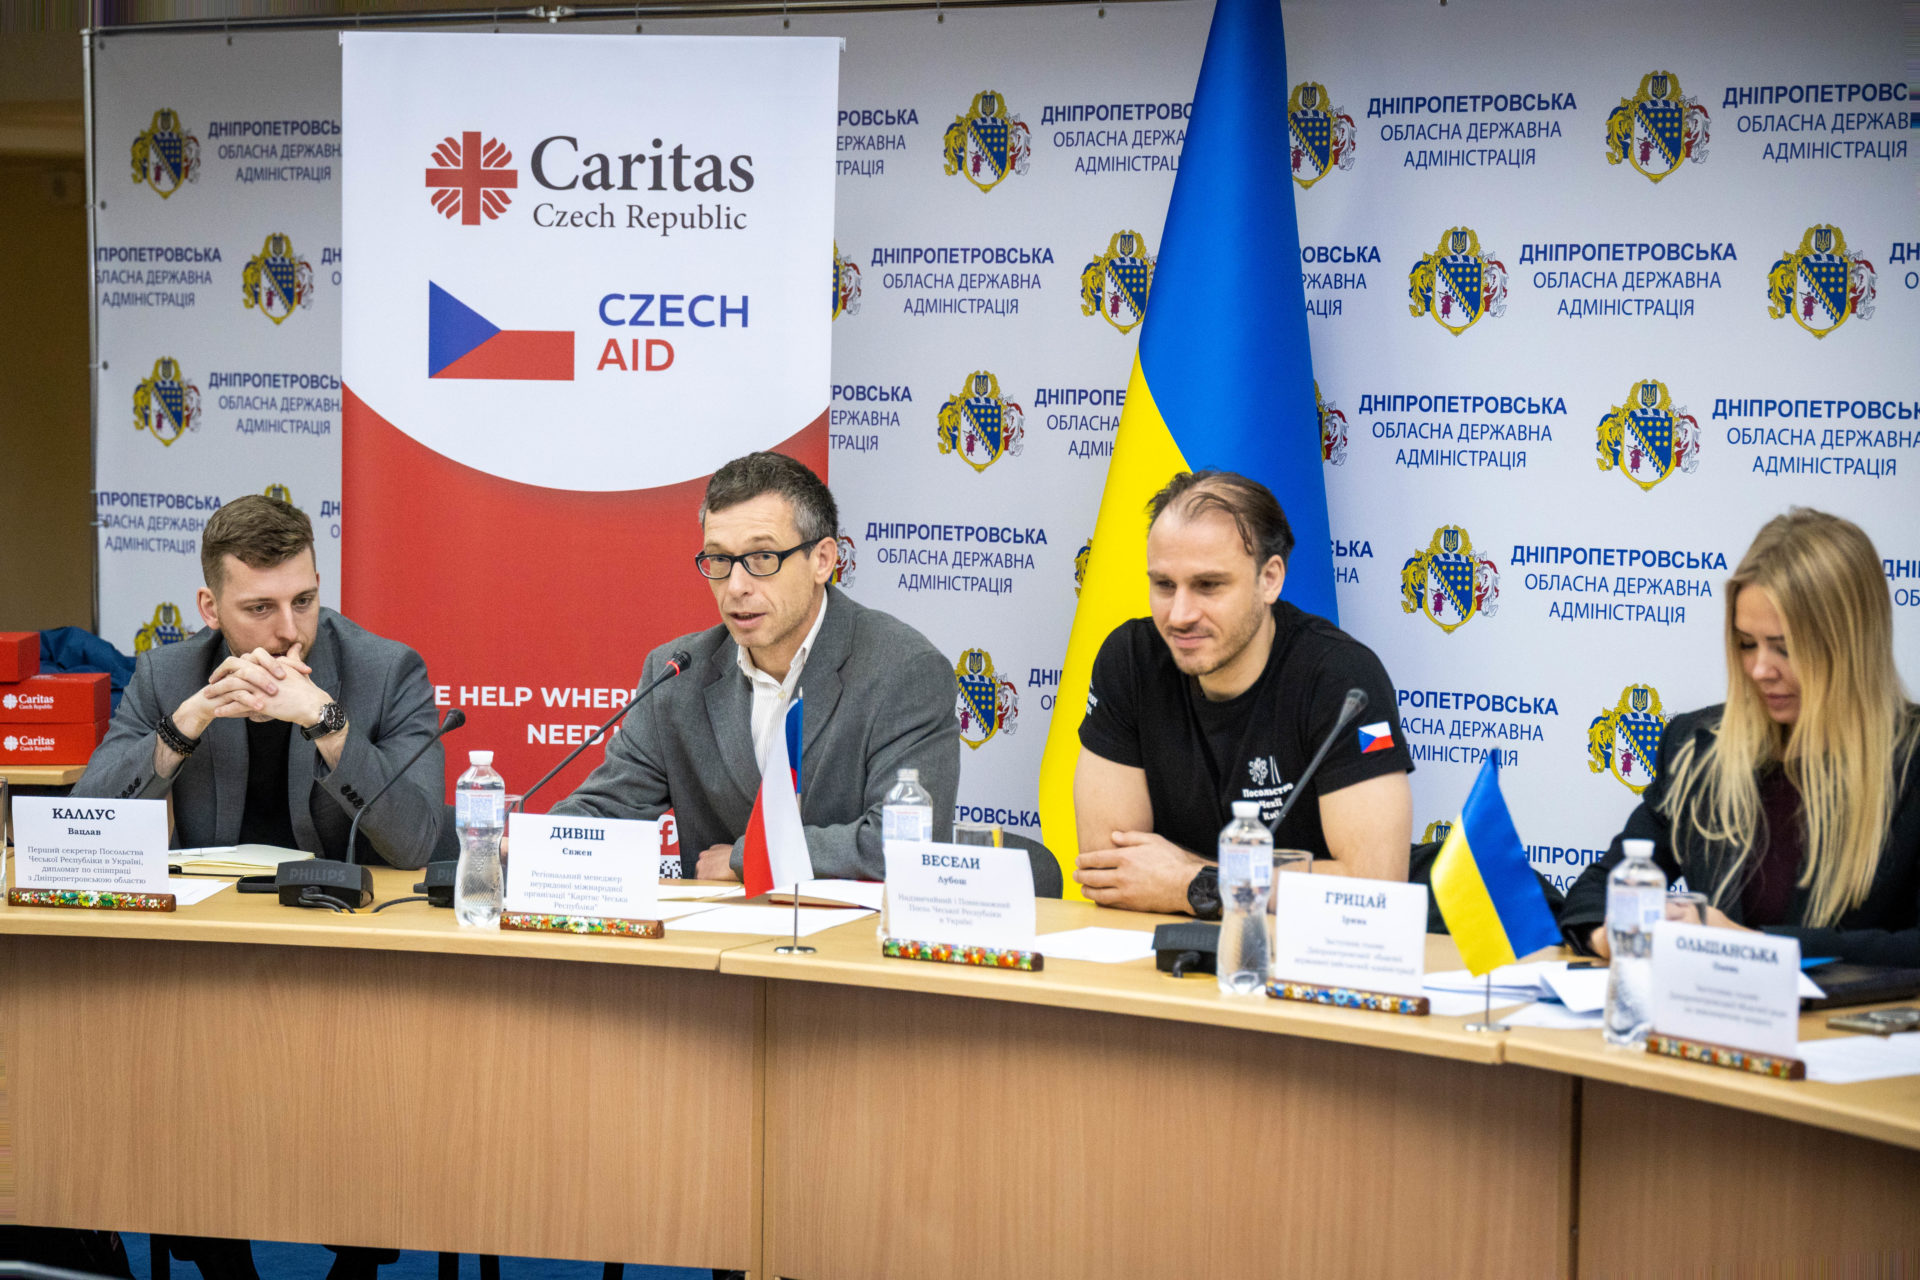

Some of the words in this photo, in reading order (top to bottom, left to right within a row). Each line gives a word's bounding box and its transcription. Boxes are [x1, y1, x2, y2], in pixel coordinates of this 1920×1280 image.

[1367, 92, 1577, 118] ДНІПРОПЕТРОВСЬКА
[1380, 123, 1462, 142] ОБЛАСНА
[1466, 121, 1562, 143] ДЕРЖАВНА
[1737, 113, 1826, 132] ОБЛАСНА
[1053, 130, 1128, 148] ОБЛАСНА
[218, 144, 278, 160] ОБЛАСНА
[280, 143, 342, 161] ДЕРЖАВН
[1403, 148, 1536, 170] АДМІНІСТРАЦІЯ
[1762, 140, 1907, 163] АДМІНІСТРАЦІЯ
[531, 135, 755, 193] Caritas
[235, 166, 331, 183] АДМІНІСТРАЦІЯ
[533, 203, 616, 228] Czech
[626, 203, 748, 236] Republic
[871, 247, 1055, 267] ДНІПРОПЕТРОВСЬКА
[1519, 243, 1737, 265] ДНІПРОПЕТРОВСЬКА
[146, 269, 213, 287] ДЕРЖАВНА
[883, 273, 954, 289] ОБЛАСНА
[958, 273, 1041, 291] ДЕРЖАВНА
[1533, 271, 1618, 289] ОБЛАСНА
[1622, 271, 1721, 292] ДЕРЖАВНА
[102, 292, 195, 307] АДМІНІСТРАЦІЯ
[903, 298, 1019, 317] АДМІНІСТРАЦІЯ
[1557, 299, 1694, 319] АДМІНІСТРАЦІЯ
[598, 293, 749, 328] CZECH
[596, 338, 675, 371] AID
[830, 384, 912, 402] РОВСЬКА
[218, 395, 278, 411] ОБЛАСНА
[280, 397, 342, 414] ДЕРЖАВН
[1359, 394, 1567, 415] ДНІПРОПЕТРОВСЬКА
[236, 418, 331, 436] АДМІНІСТРАЦІЯ
[1372, 421, 1453, 439] ОБЛАСНА
[1457, 423, 1552, 443] ДЕРЖАВНА
[1727, 427, 1816, 446] ОБЛАСНА
[1396, 448, 1526, 471] АДМІНІСТРАЦІЯ
[1752, 455, 1897, 479] АДМІНІСТРАЦІЯ
[865, 522, 1048, 545] ДНІПРОПЕТРОВСЬКА
[105, 536, 196, 554] АДМІНІСТРАЦІЯ
[877, 547, 949, 566] ОБЛАСНА
[952, 551, 1035, 570] ДЕРЖАВНА
[1510, 545, 1728, 570] ДНІПРОПЕТРОВСЬКА
[898, 573, 1013, 596] АДМІНІСТРАЦІЯ
[1524, 573, 1609, 593] ОБЛАСНА
[1613, 577, 1713, 597] ДЕРЖАВНА
[1549, 601, 1686, 626] АДМІНІСТРАЦІЯ
[18, 693, 54, 704] Caritas
[460, 686, 533, 707] HELP
[19, 735, 55, 746] Caritas
[527, 723, 605, 745] NEED
[1449, 720, 1544, 742] ДЕРЖАВНА
[52, 808, 116, 821] КАЛЛУС
[68, 827, 101, 836] Вацлав
[550, 826, 605, 841] ДИВІШ
[921, 854, 981, 870] ВЕСЕЛИ
[289, 868, 346, 882] PHILIPS
[1325, 891, 1387, 909] ГРИЦАЙ
